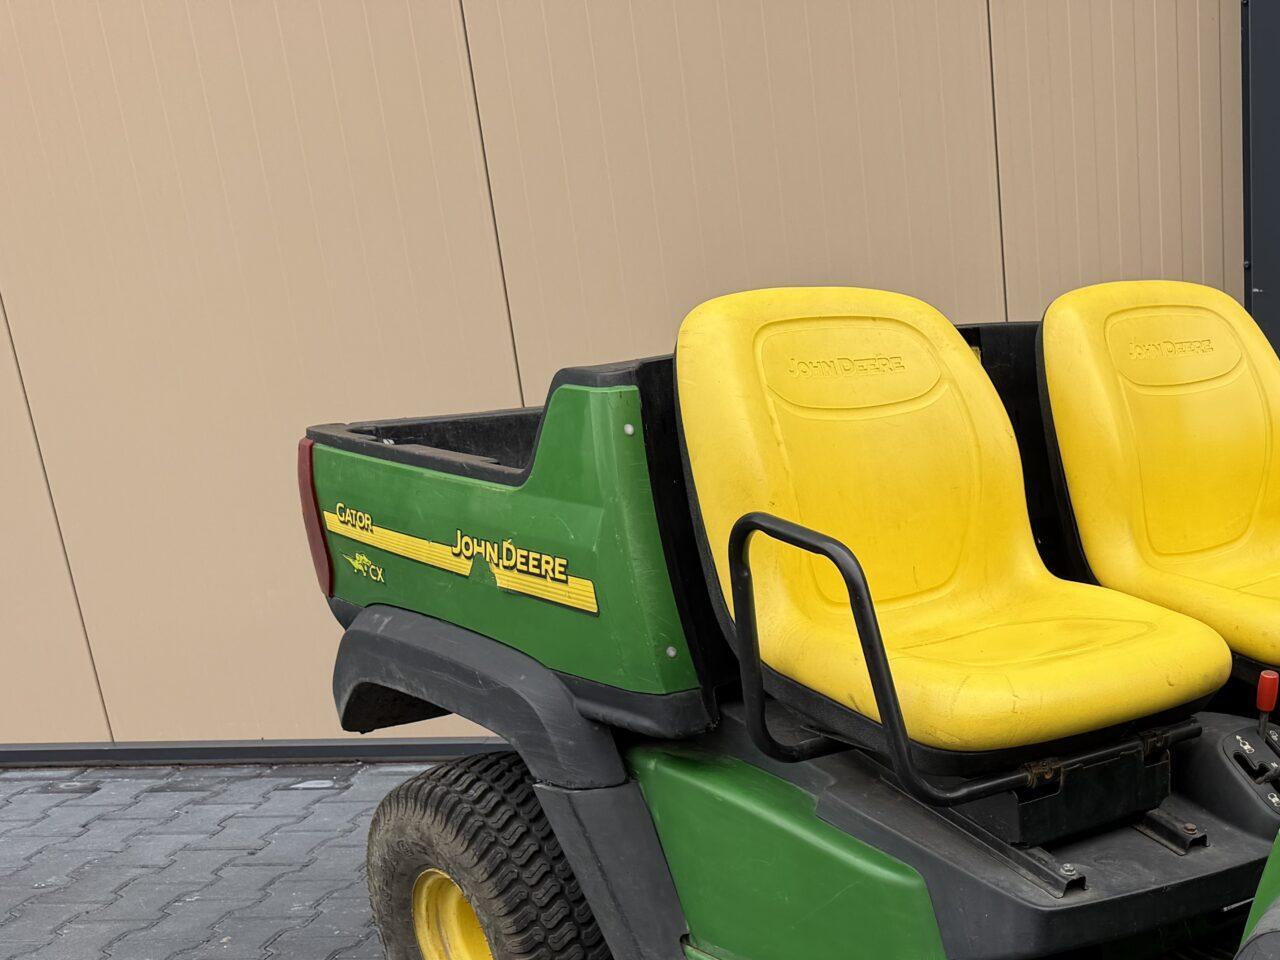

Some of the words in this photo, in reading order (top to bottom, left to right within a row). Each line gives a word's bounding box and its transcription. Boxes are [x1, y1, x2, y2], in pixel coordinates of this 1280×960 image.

[1127, 341, 1163, 360] JOHN
[1162, 338, 1215, 358] DEERE
[787, 357, 839, 378] JOHN
[836, 355, 907, 377] DEERE
[335, 502, 373, 532] GATOR
[451, 528, 499, 566] JOHN
[499, 539, 569, 584] DEERE
[368, 564, 385, 583] CX
